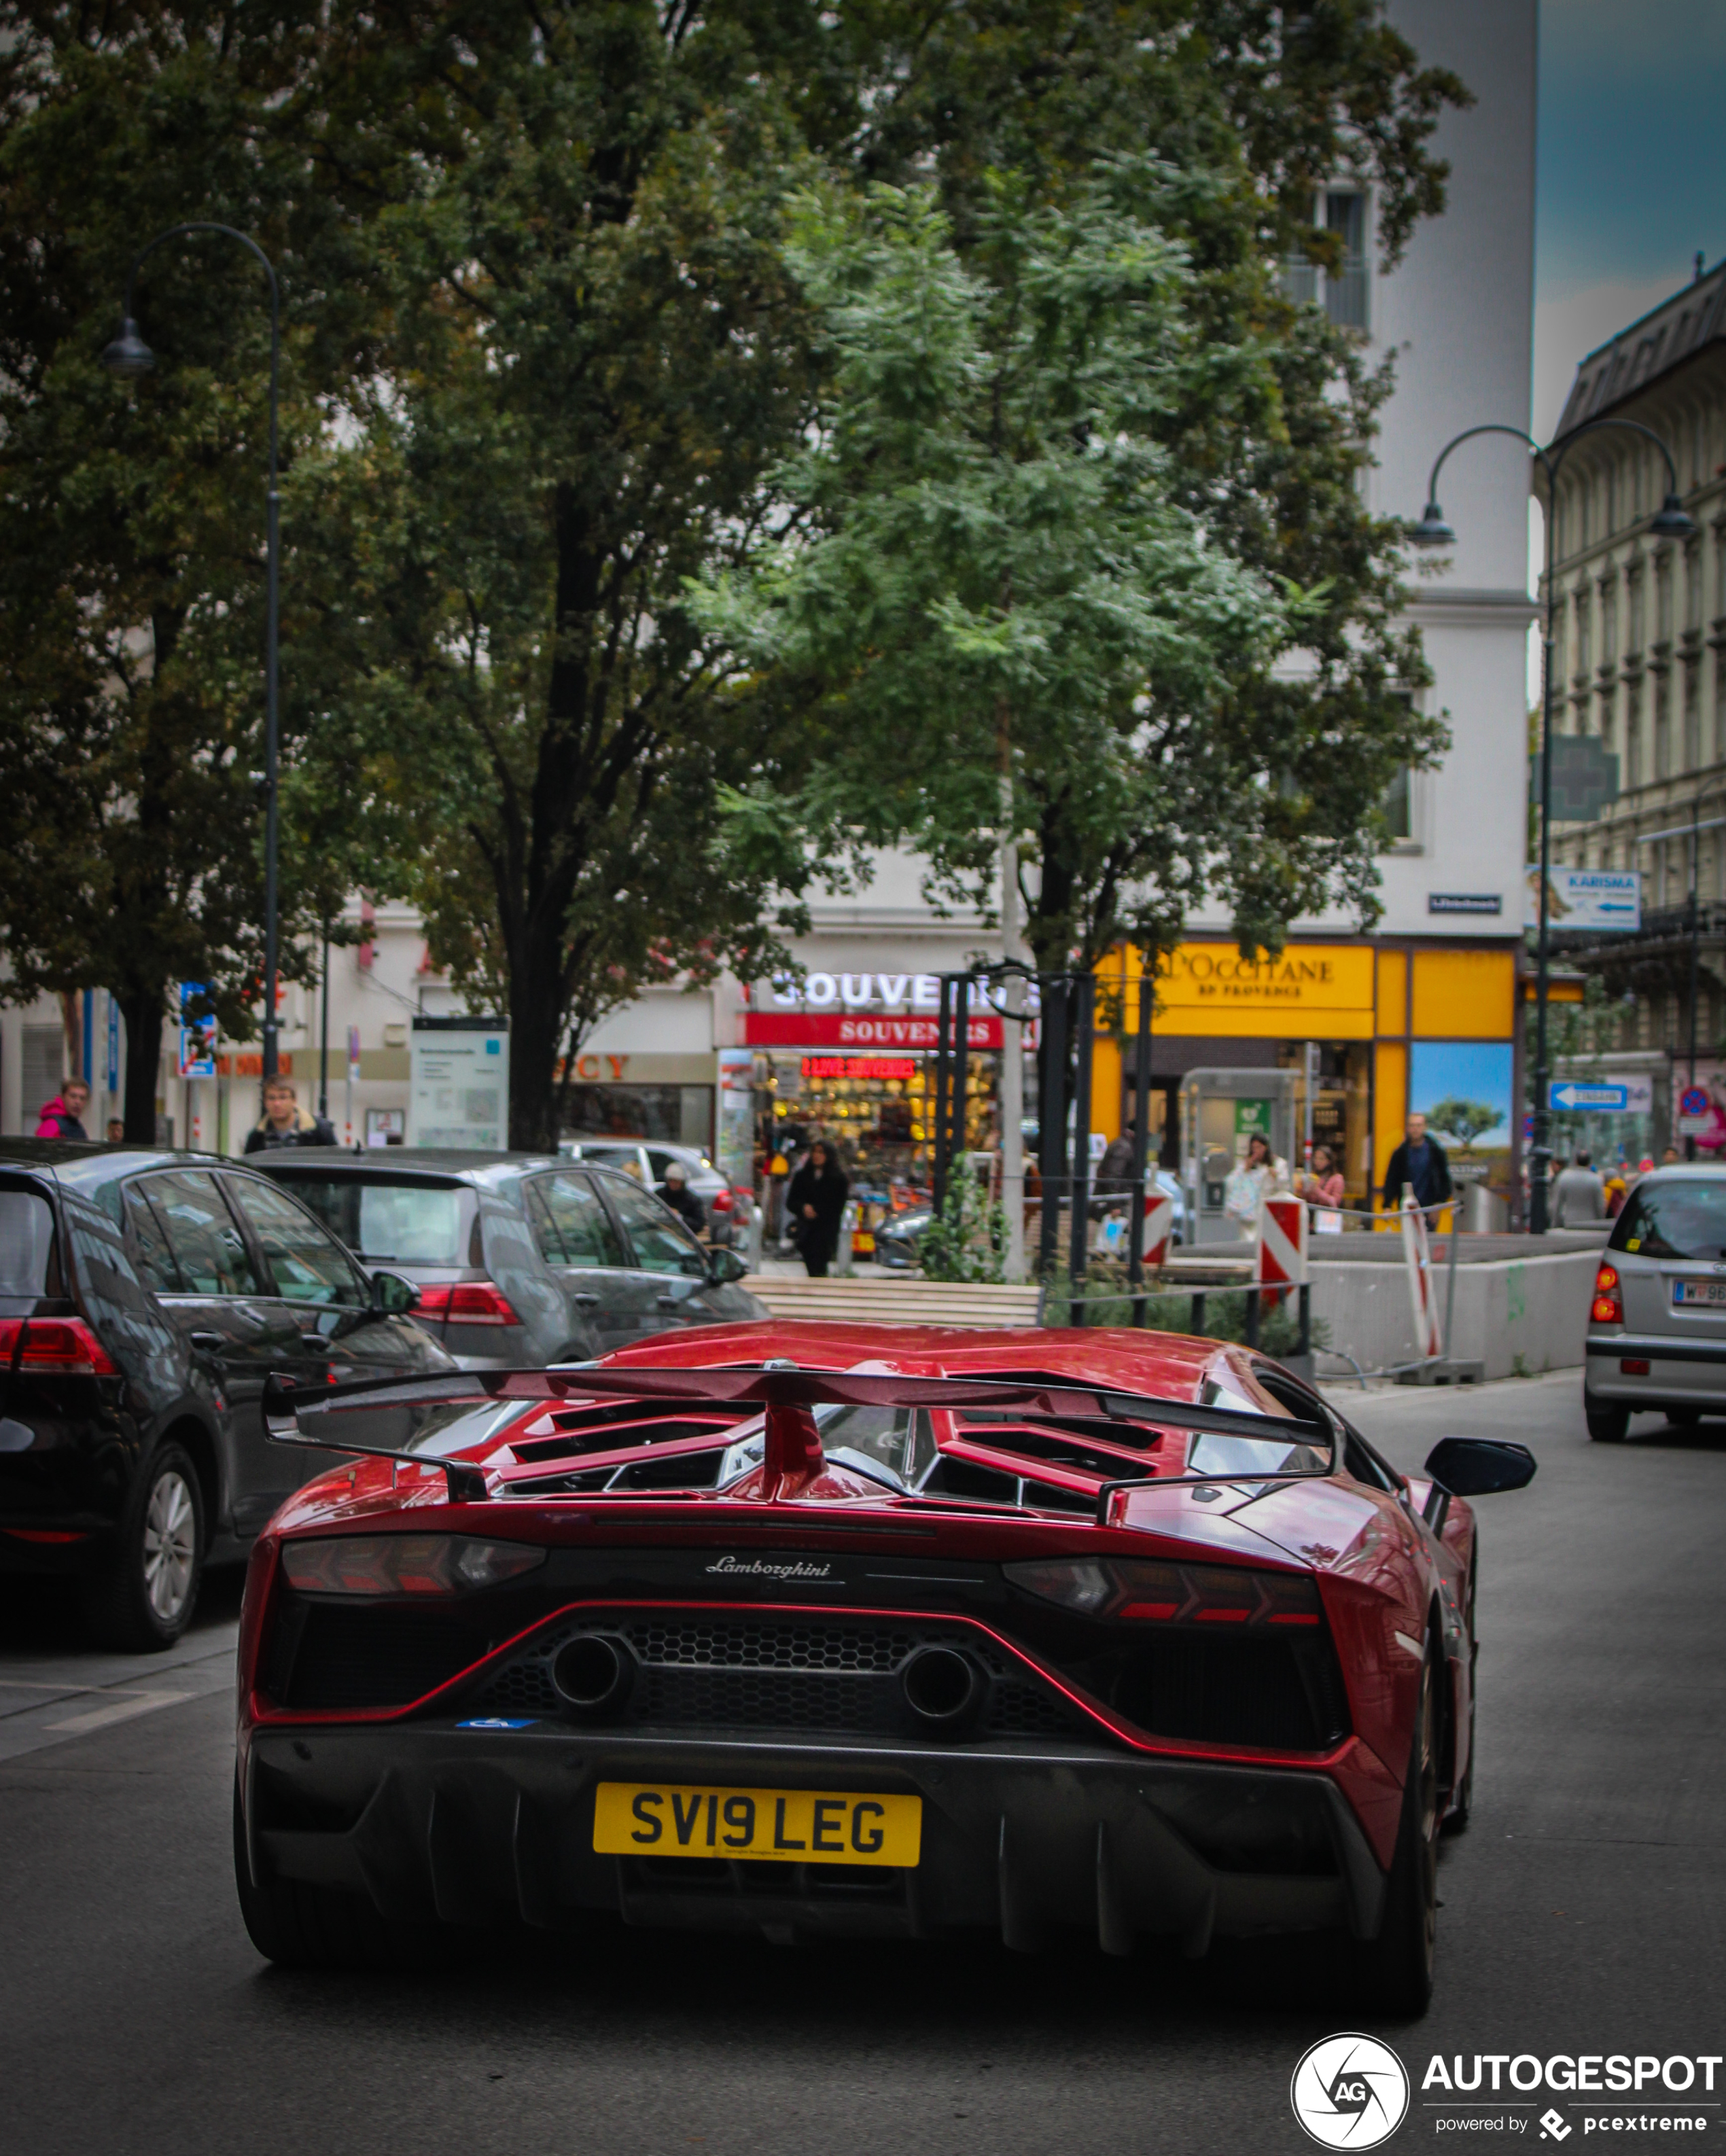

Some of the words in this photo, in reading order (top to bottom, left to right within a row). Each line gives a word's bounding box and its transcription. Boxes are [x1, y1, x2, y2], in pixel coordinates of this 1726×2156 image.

[1569, 874, 1635, 888] KARISMA
[1165, 951, 1333, 983] L'OCCITANE
[1198, 985, 1216, 997] EN
[1225, 985, 1301, 999] PROVENCE
[705, 1556, 830, 1578] Lamborghini
[631, 1792, 756, 1848] SV19
[774, 1797, 885, 1854] LEG
